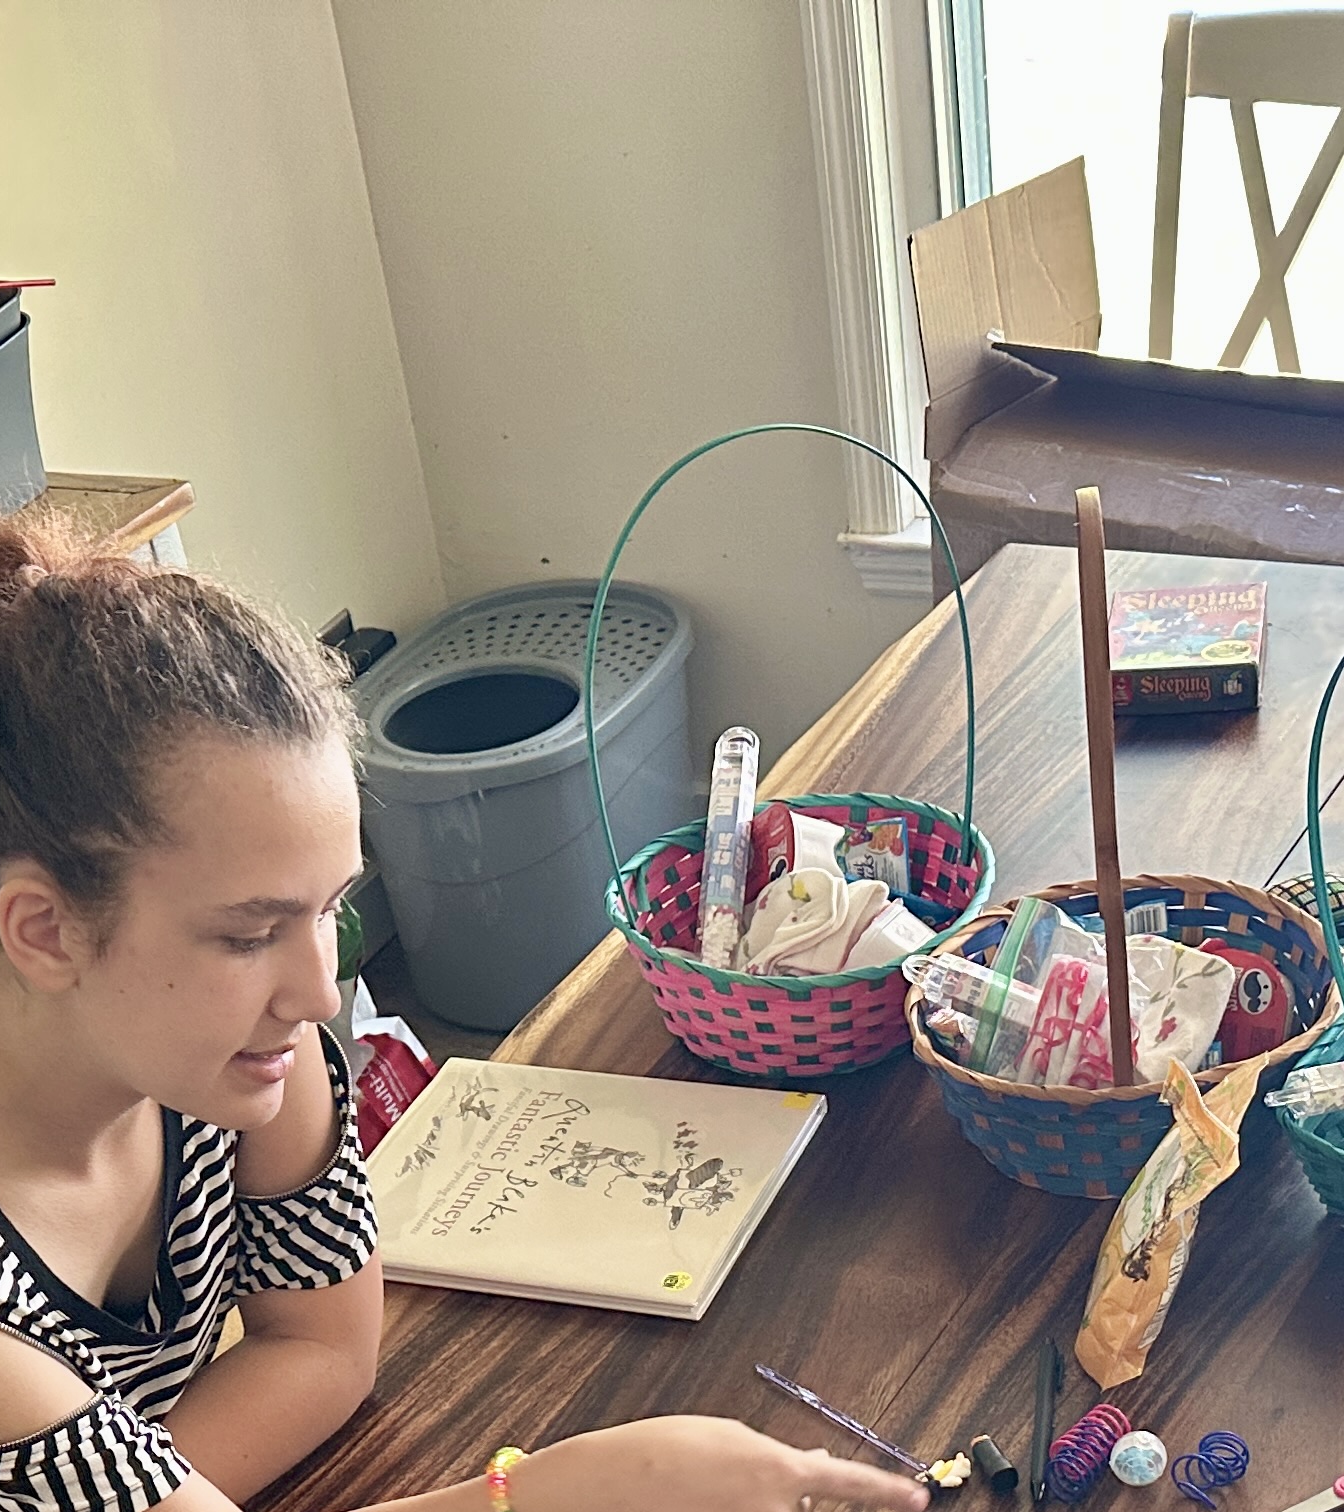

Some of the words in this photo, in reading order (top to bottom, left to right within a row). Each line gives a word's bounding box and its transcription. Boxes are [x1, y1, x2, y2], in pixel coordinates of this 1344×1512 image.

[1121, 588, 1257, 612] Sleeping
[1141, 675, 1211, 700] Sleeping
[490, 1090, 564, 1161] Fantastic
[524, 1097, 591, 1167] Quentin
[431, 1163, 506, 1237] Journeys
[469, 1169, 539, 1235] Blake's
